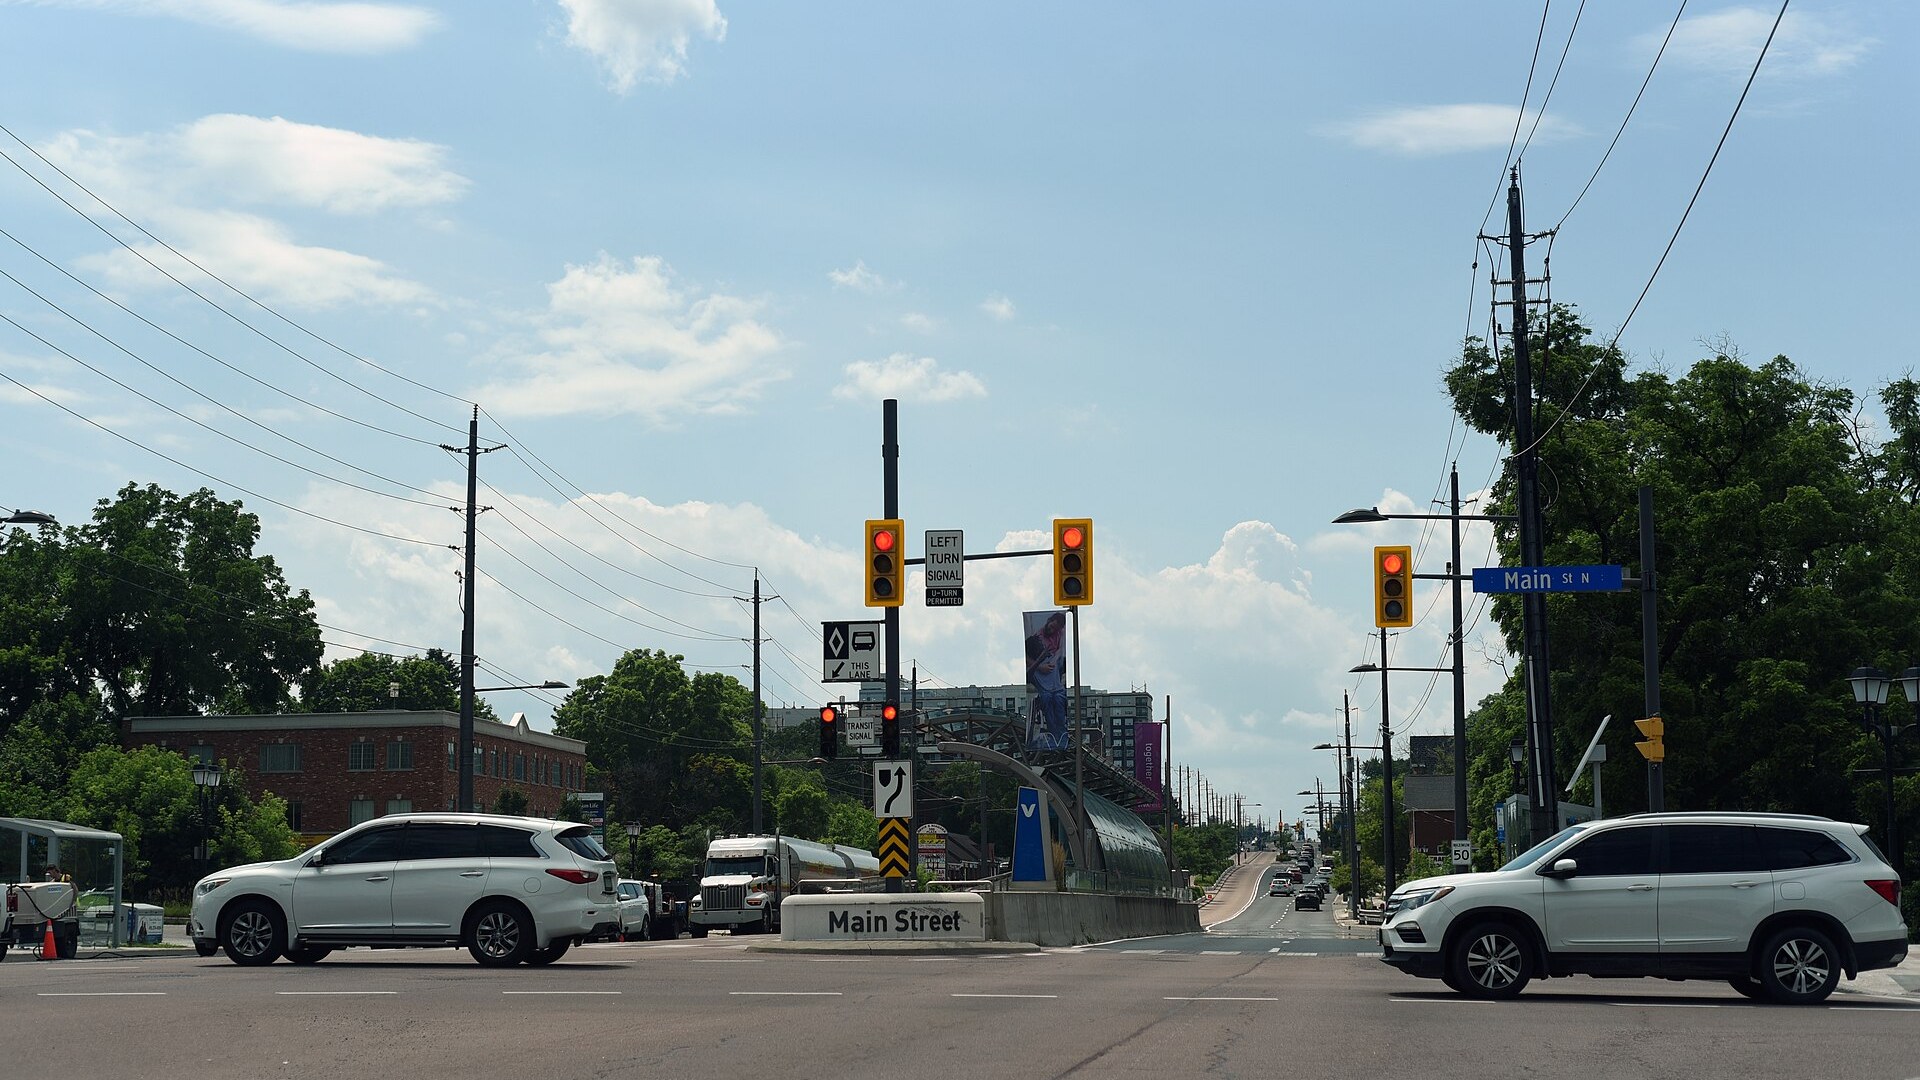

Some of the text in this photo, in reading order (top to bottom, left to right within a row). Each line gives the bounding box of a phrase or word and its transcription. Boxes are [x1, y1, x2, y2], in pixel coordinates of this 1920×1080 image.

[930, 536, 958, 548] LEFT
[930, 553, 959, 564] TURN
[927, 570, 962, 581] SIGNAL
[1504, 569, 1590, 590] Main St N
[931, 589, 958, 597] U-TURN
[927, 597, 962, 605] PERMITTED
[851, 661, 870, 670] THIS
[849, 670, 871, 679] LANE
[847, 722, 874, 730] TRANSIT
[849, 732, 872, 740] SIGNAL
[1143, 743, 1153, 782] together
[1454, 849, 1469, 860] 50
[828, 910, 961, 933] Main Street
